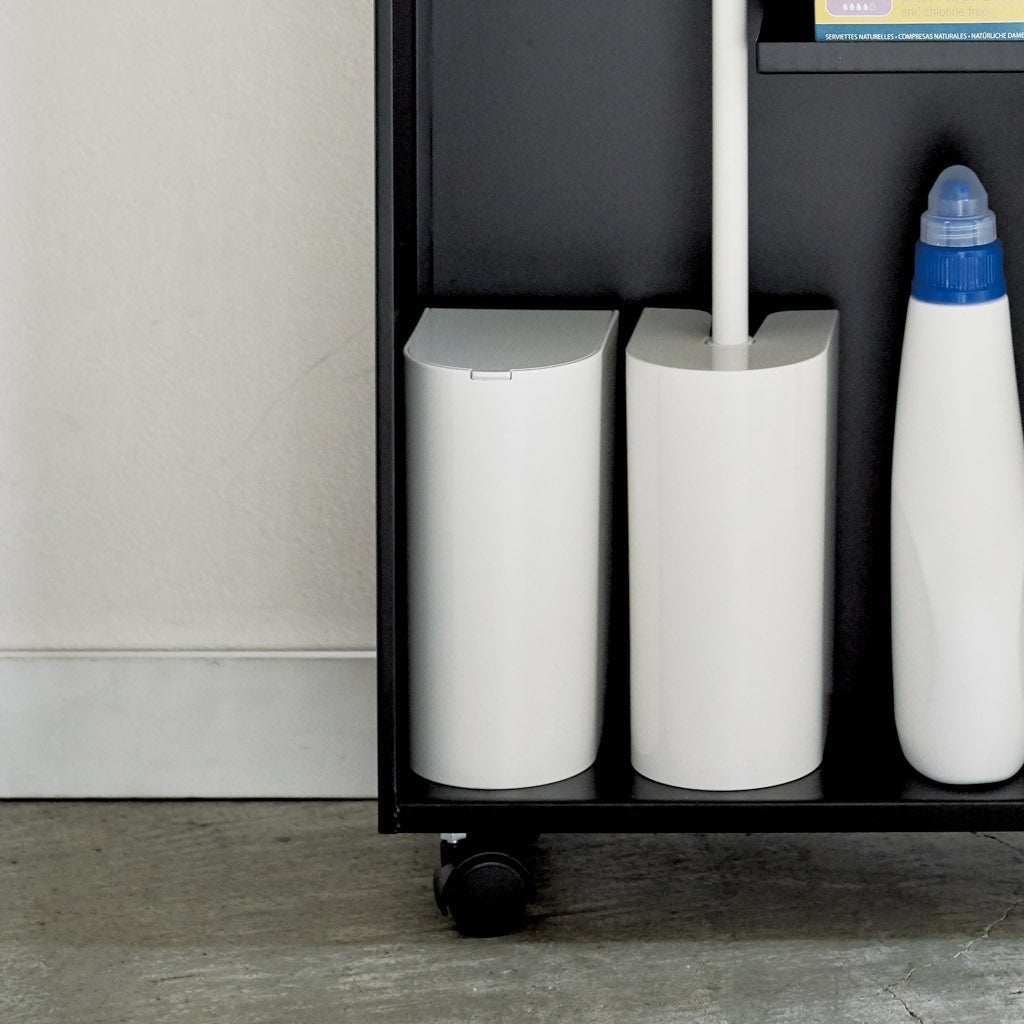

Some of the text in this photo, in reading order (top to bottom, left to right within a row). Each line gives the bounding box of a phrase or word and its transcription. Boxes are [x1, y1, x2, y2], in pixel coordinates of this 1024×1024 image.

[903, 5, 989, 17] and chlorine free
[825, 33, 858, 41] SERVIETTES
[933, 32, 967, 40] NATURALES
[971, 31, 1007, 39] NATÜRLICHE
